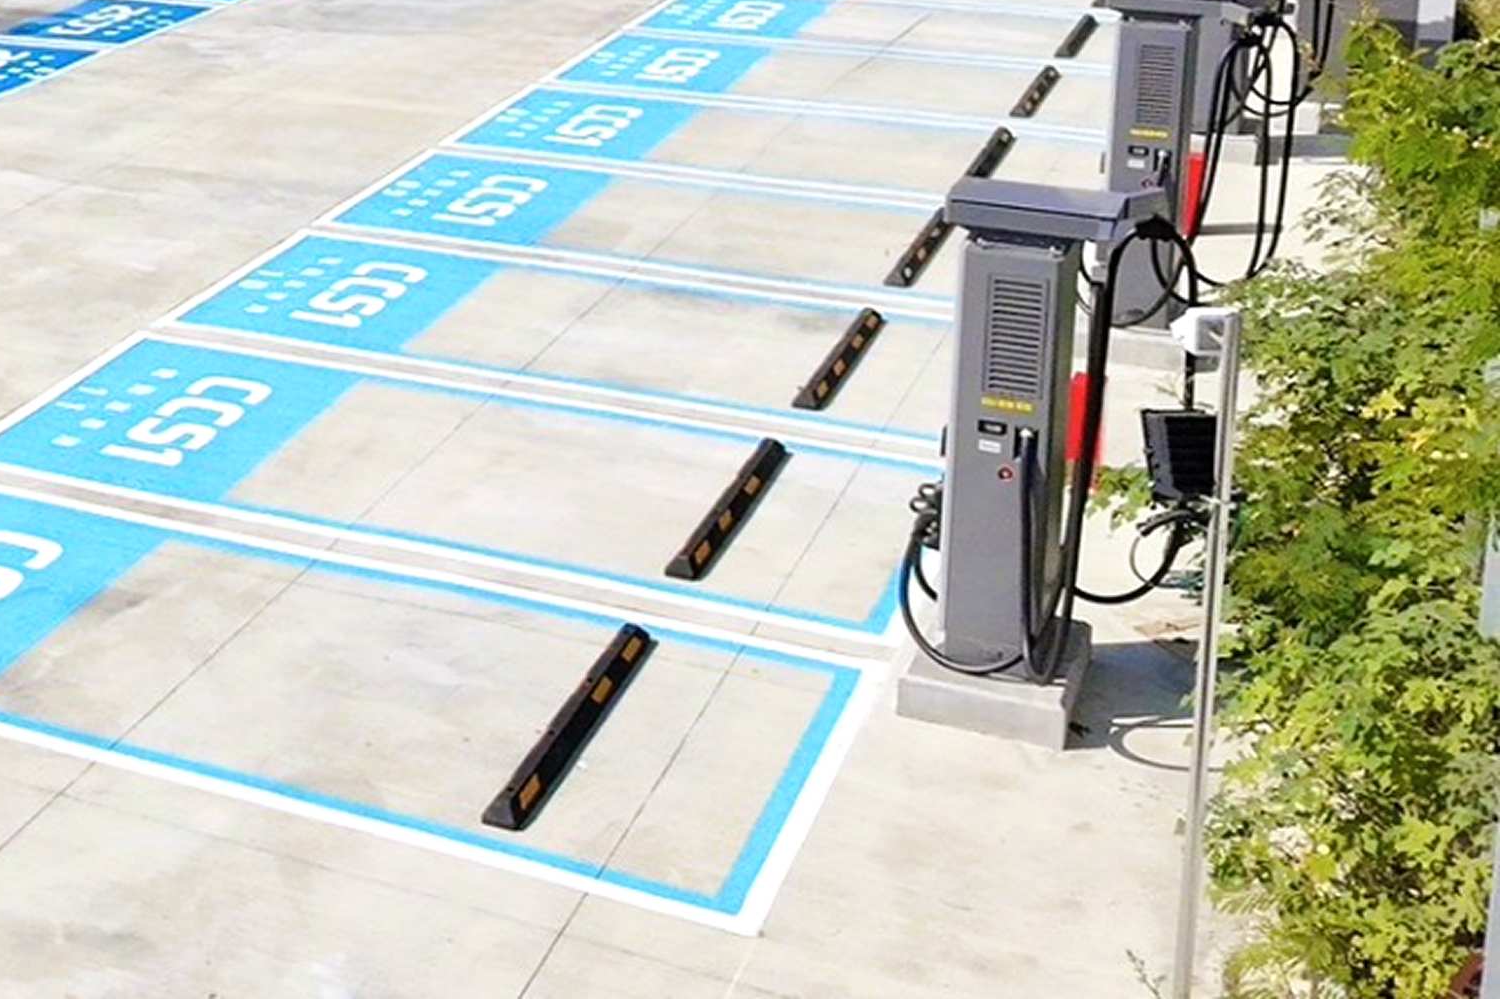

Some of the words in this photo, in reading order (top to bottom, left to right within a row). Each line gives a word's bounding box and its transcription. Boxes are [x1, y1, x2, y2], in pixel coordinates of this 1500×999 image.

[47, 4, 151, 35] CCS2
[542, 104, 644, 147] CCS1
[430, 173, 549, 227] CCS1
[289, 260, 429, 328] CCS1
[99, 375, 274, 468] CCS1
